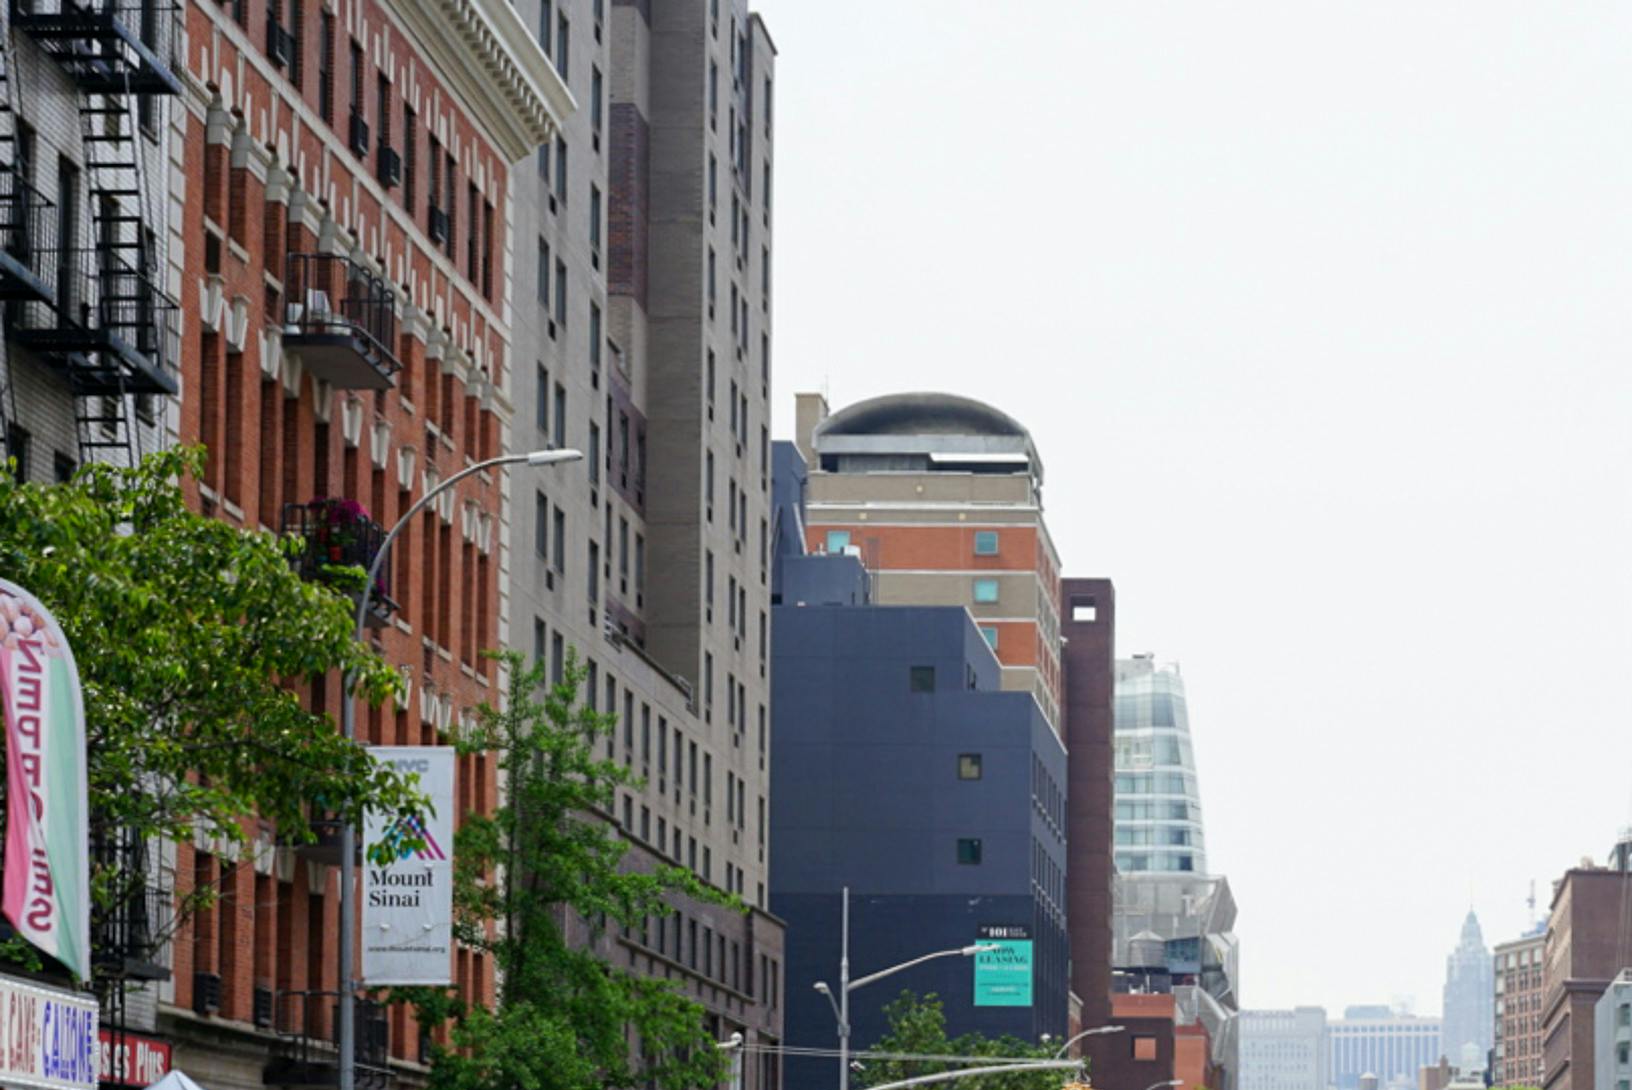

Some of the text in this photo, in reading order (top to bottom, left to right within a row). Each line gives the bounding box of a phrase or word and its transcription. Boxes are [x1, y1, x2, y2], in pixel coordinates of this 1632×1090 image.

[370, 869, 434, 887] Mount
[369, 890, 420, 907] Sinai
[137, 1040, 165, 1083] Plus
